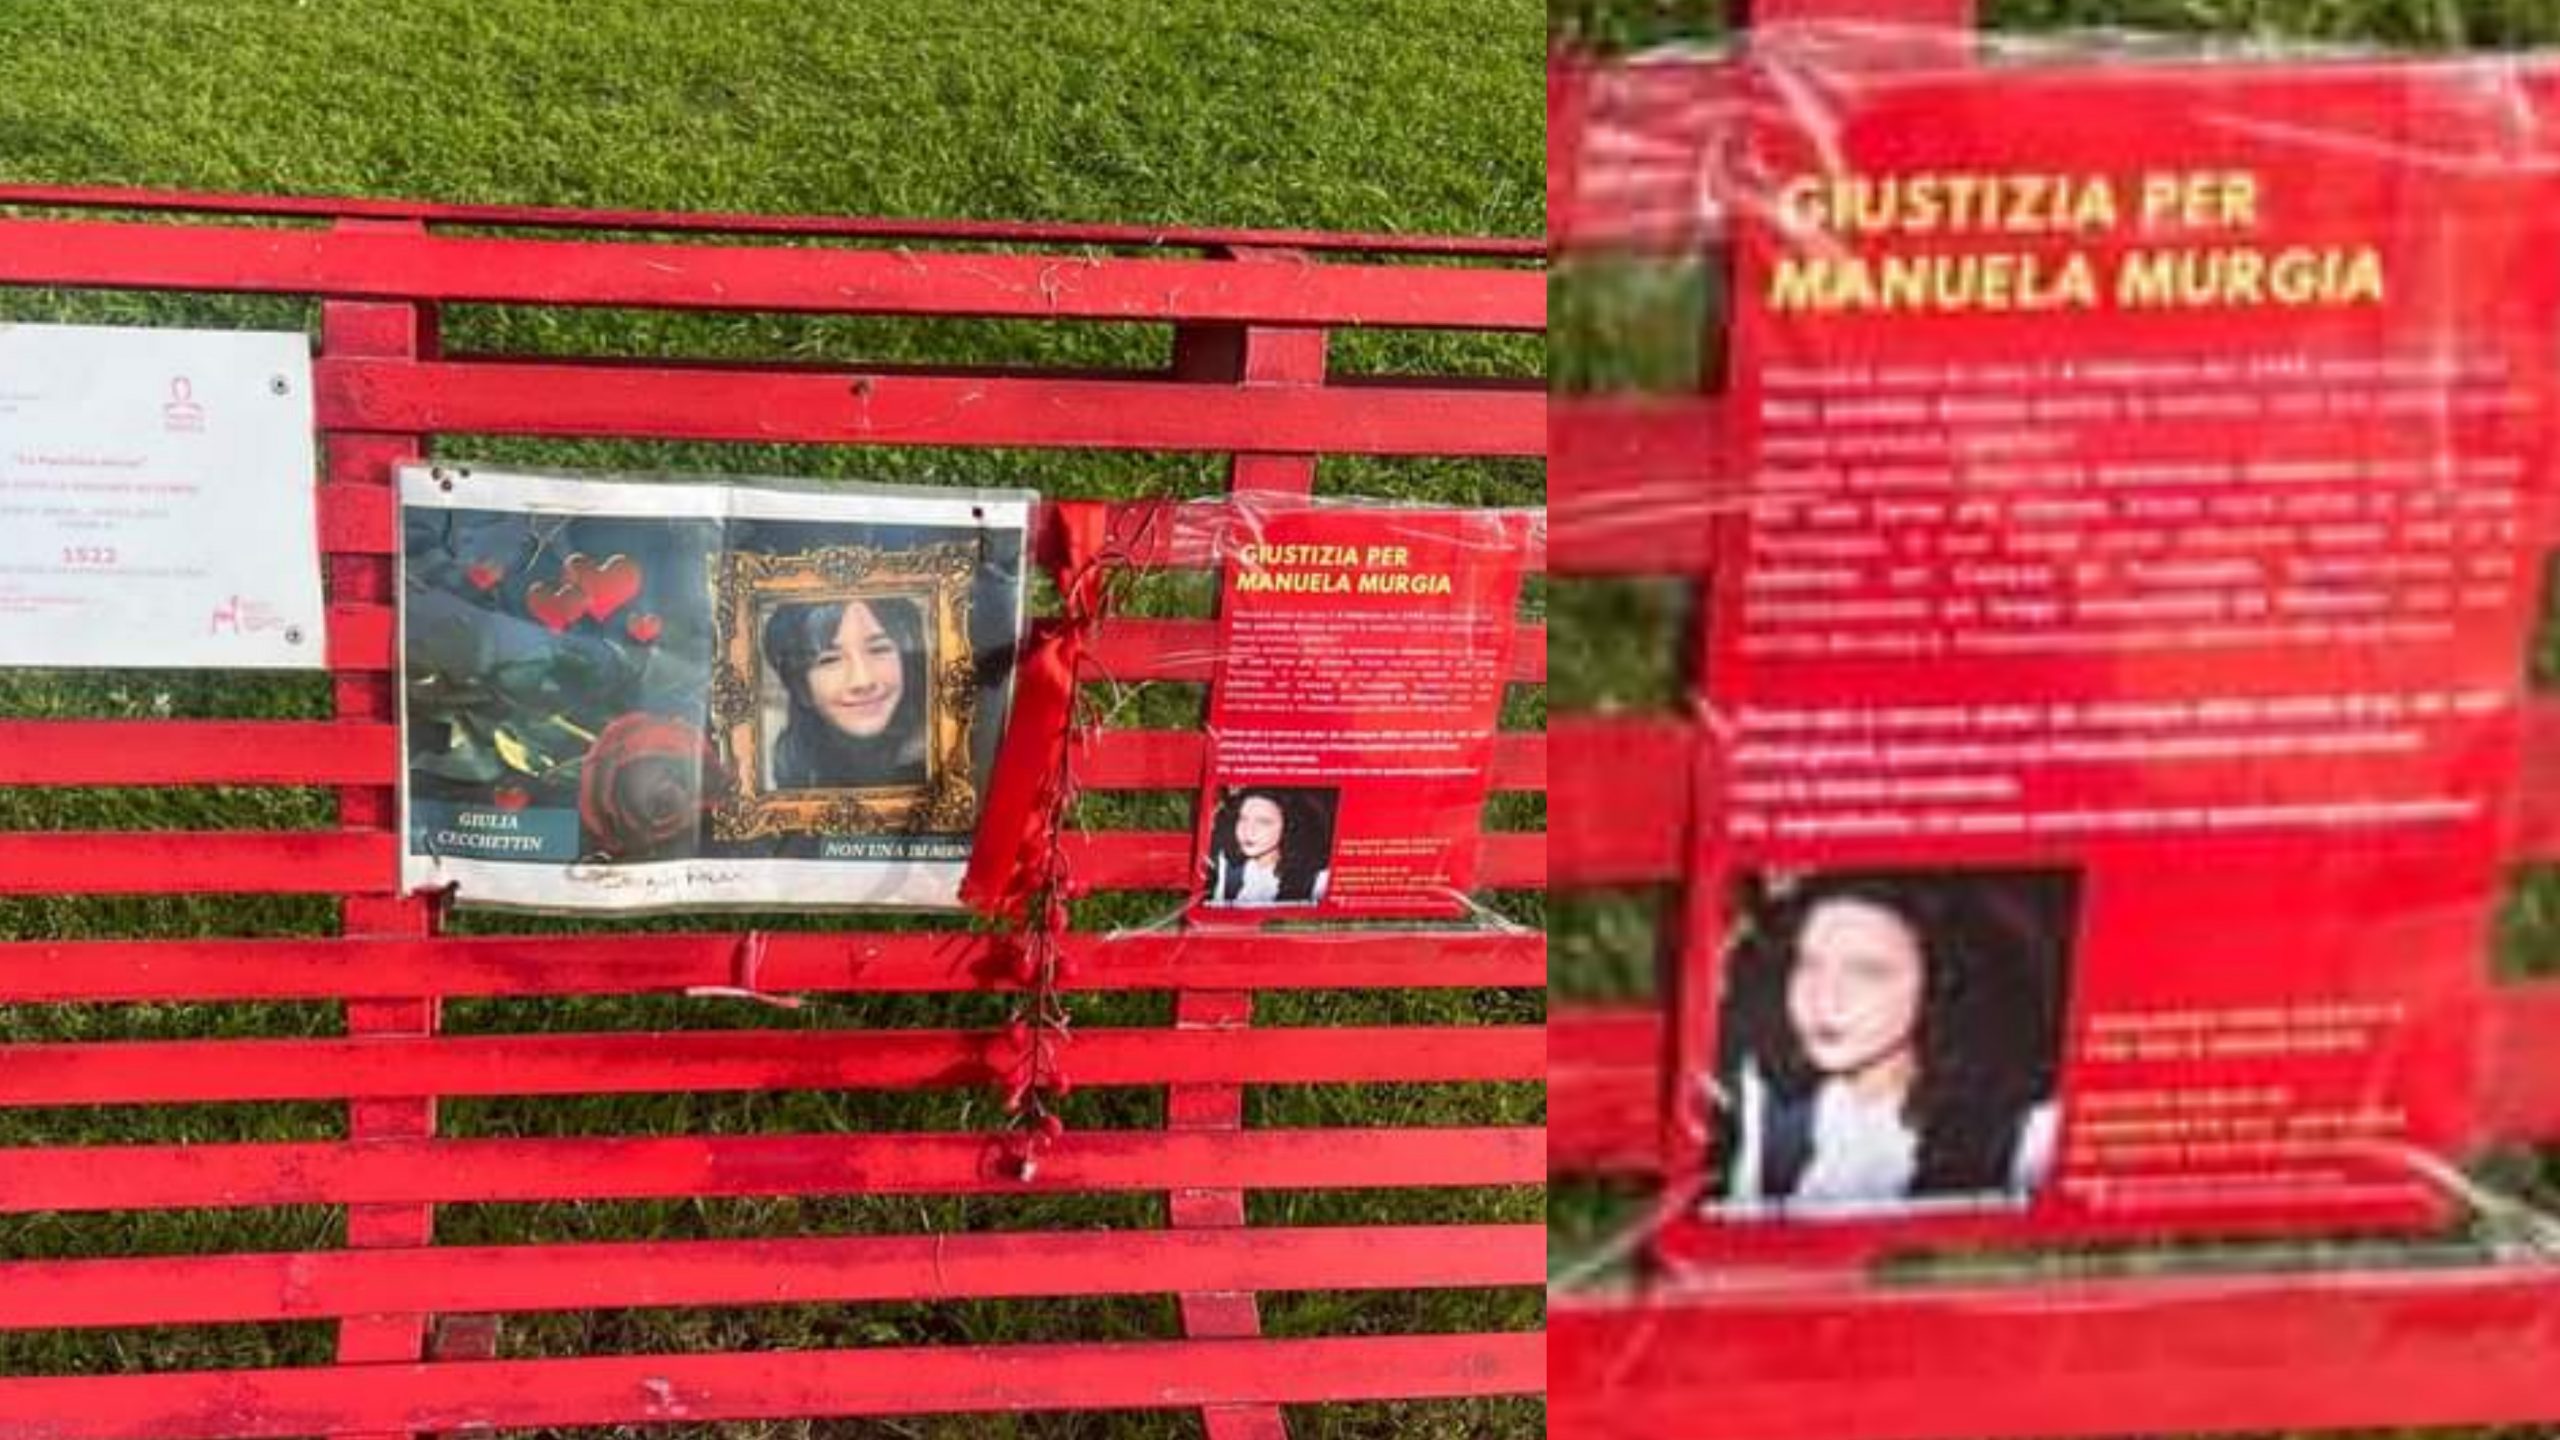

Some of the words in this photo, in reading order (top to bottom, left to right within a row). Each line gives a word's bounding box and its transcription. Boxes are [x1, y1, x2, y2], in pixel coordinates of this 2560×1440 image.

[1778, 171, 2117, 236] GIUSTIZIA
[2141, 169, 2258, 231] PER
[1769, 251, 2098, 310] MANUELA
[2116, 246, 2384, 308] MURGIA
[62, 547, 116, 564] 1522
[1239, 543, 1359, 567] GIUSTIZIA
[1367, 545, 1409, 567] PER
[1235, 572, 1351, 594] MANUELA
[1357, 573, 1452, 595] MURGIA
[459, 811, 518, 830] GIULIA
[824, 842, 864, 857] NON
